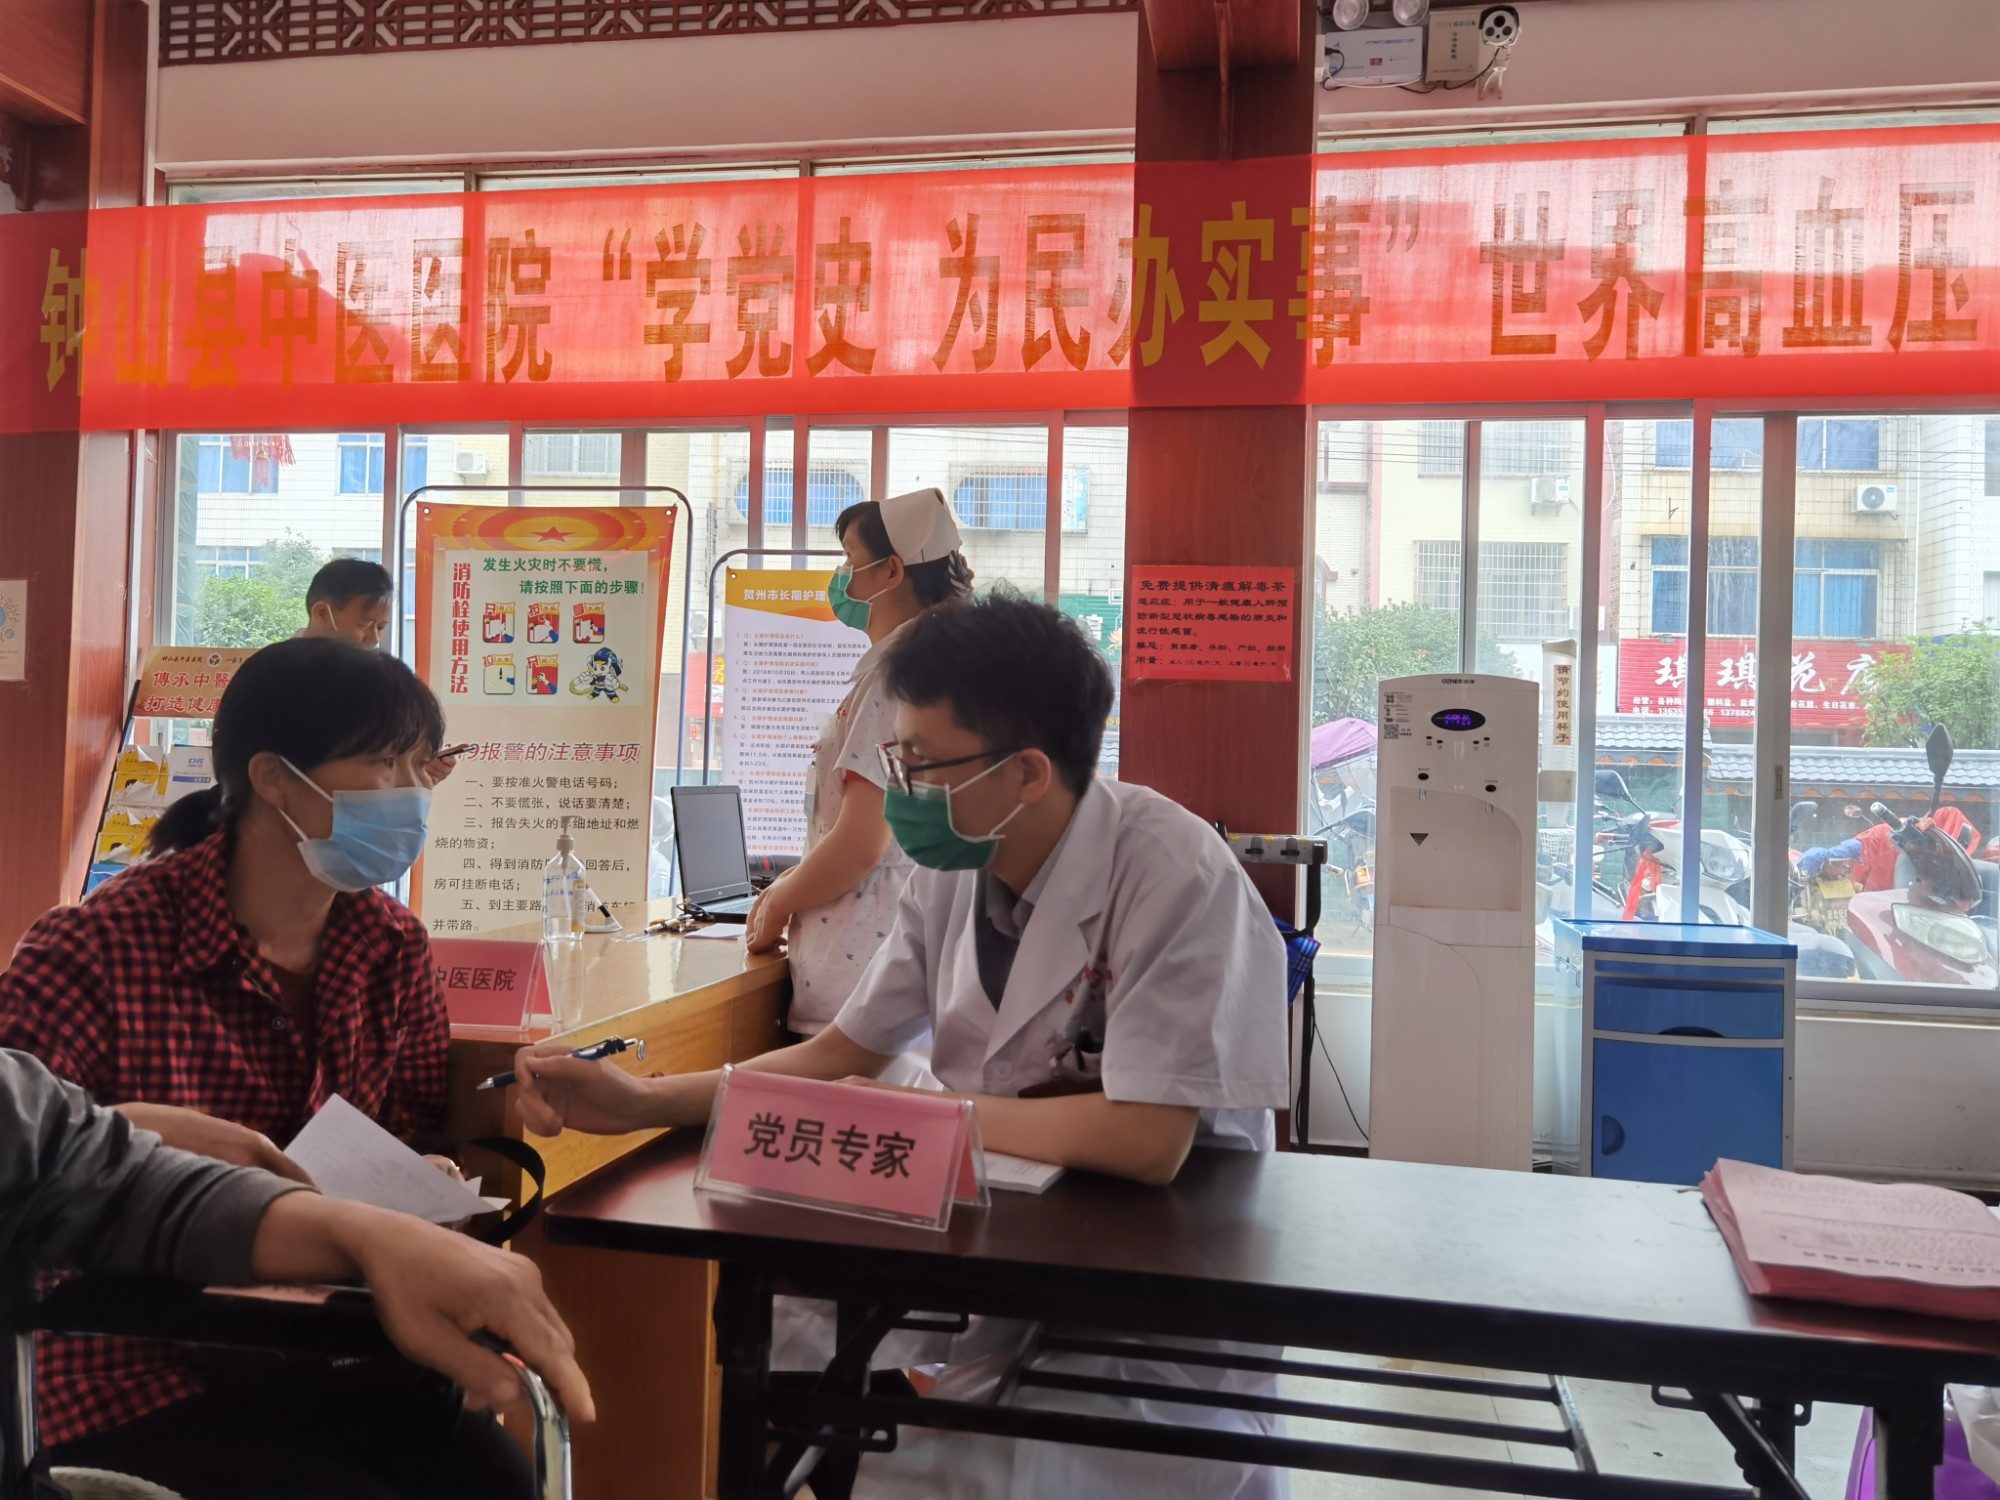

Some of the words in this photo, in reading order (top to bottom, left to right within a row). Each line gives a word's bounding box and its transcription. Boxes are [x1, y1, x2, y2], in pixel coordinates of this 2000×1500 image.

[1139, 580, 1287, 592] 免费提供清瘟解毒茶
[743, 589, 826, 602] 贺州市长期护理
[451, 562, 471, 694] 消防栓使用方法
[1556, 665, 1570, 743] 请节约使用杯子
[465, 776, 618, 789] 一、要按准火警电话号码；
[464, 797, 630, 810] 二、不要慌张，说话要清楚；
[464, 817, 640, 830] 三、报告失火的细地址和燃
[435, 837, 495, 850] 烧的物资；
[463, 857, 631, 872] 四、得到消防回答后，
[434, 878, 521, 891] 房可挂断电话；
[432, 919, 481, 932] 并带路。
[744, 1112, 916, 1179] 党员专家
